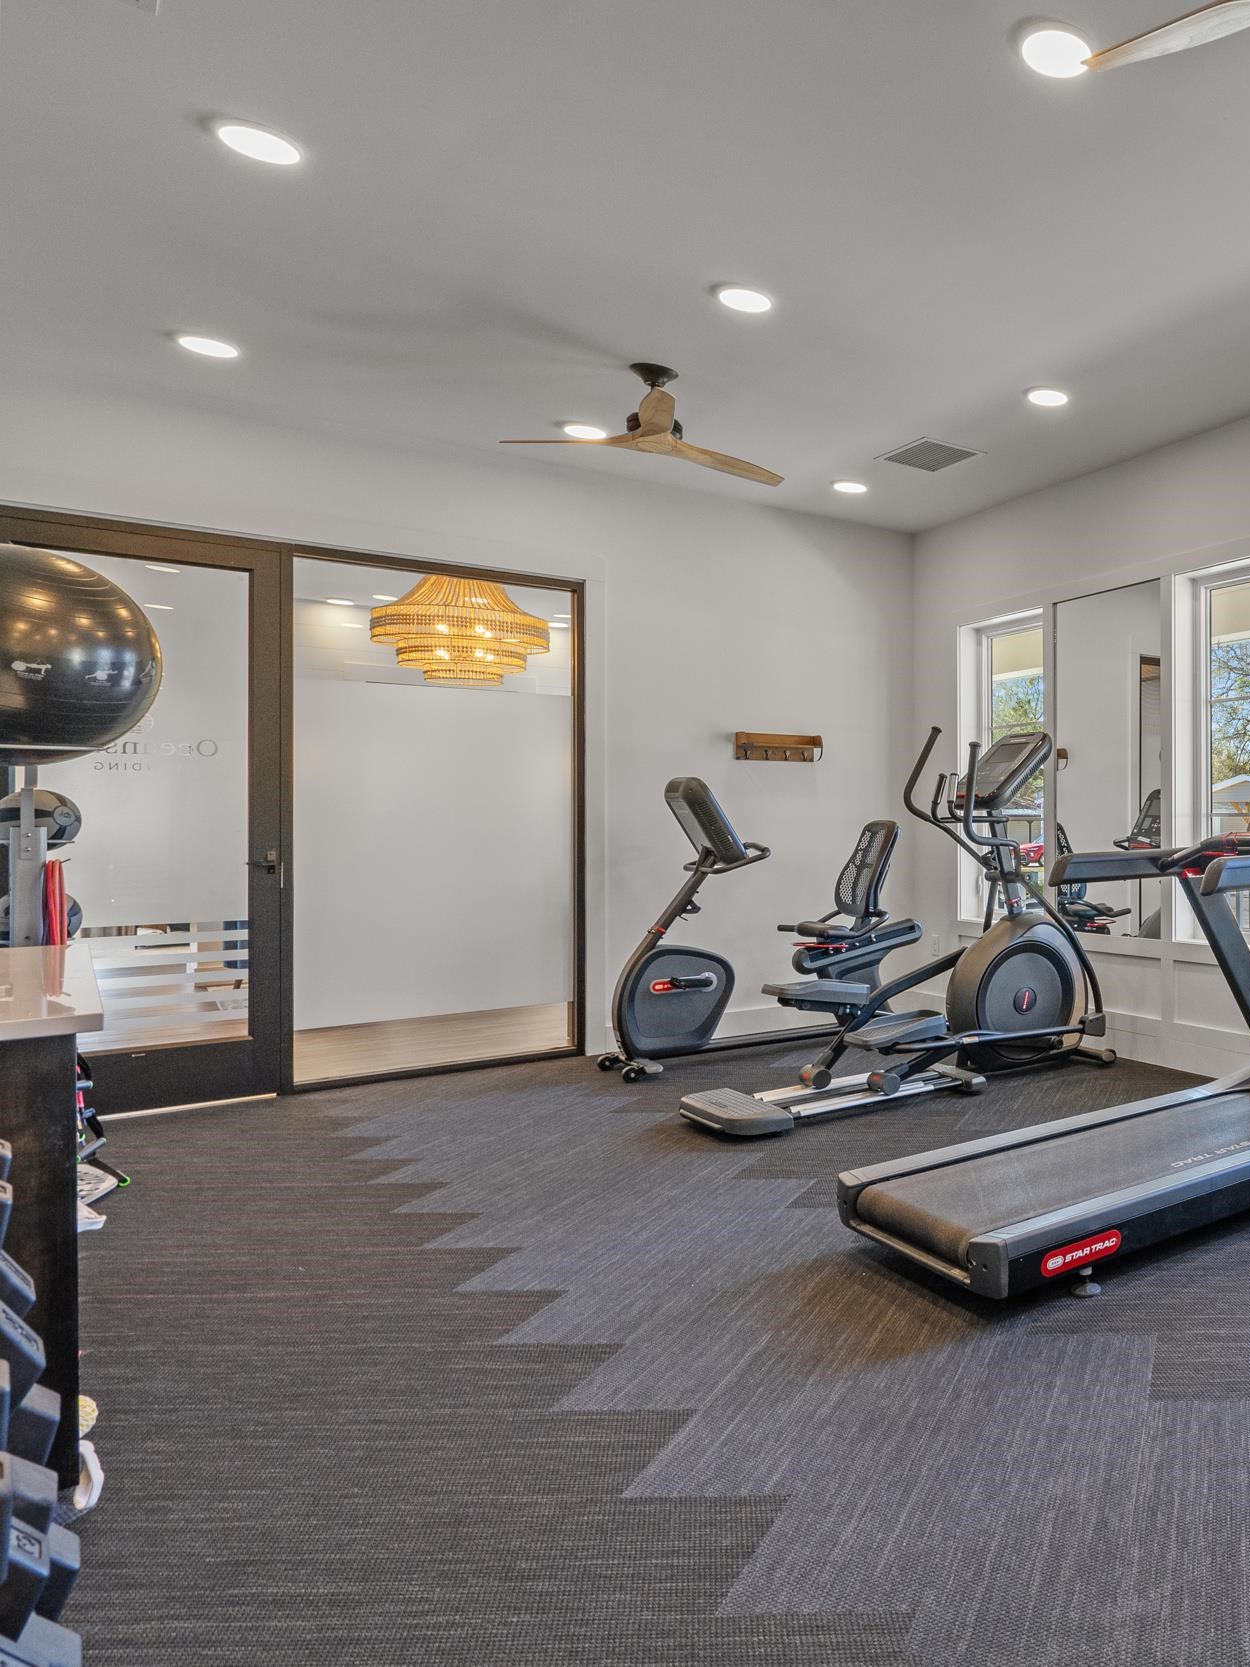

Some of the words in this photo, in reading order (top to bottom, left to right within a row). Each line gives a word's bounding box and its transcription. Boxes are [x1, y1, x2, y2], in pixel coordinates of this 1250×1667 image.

[1170, 1153, 1214, 1168] TRAC
[1064, 1247, 1090, 1263] STAR
[1091, 1237, 1117, 1253] TRAC
